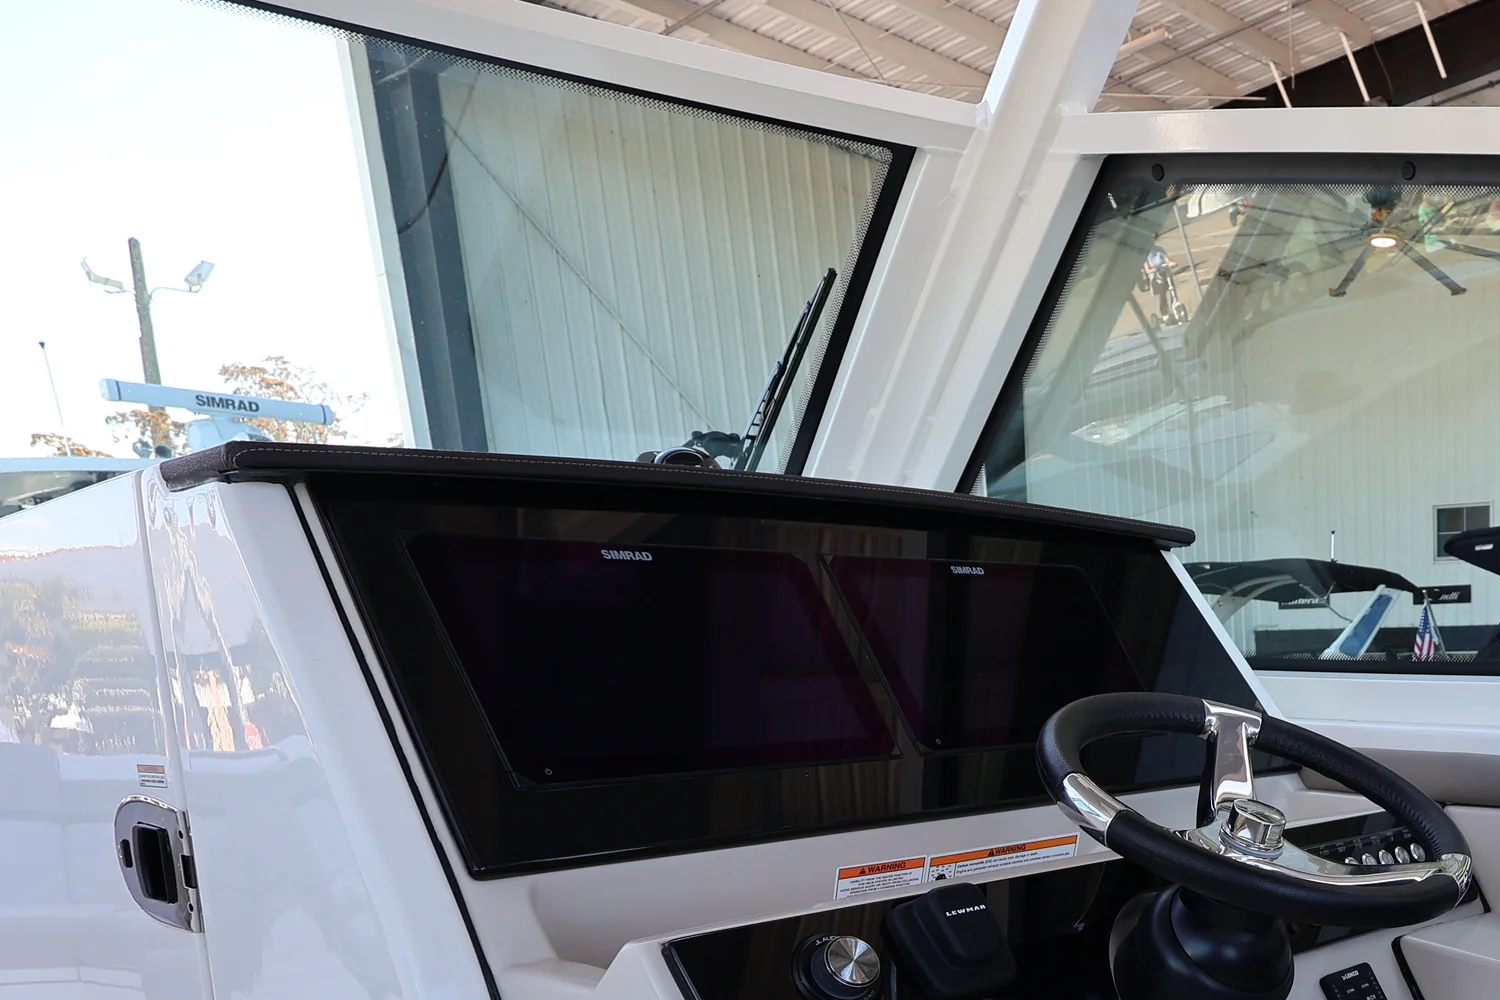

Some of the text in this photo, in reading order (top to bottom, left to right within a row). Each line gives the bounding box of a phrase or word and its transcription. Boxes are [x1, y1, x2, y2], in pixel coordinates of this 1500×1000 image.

[195, 394, 260, 412] SIMRAD
[600, 549, 653, 561] SIMRAD
[950, 565, 985, 575] SIMRAD
[993, 844, 1027, 856] WARNING
[868, 861, 907, 874] WARNING
[945, 904, 987, 917] LEWMAR
